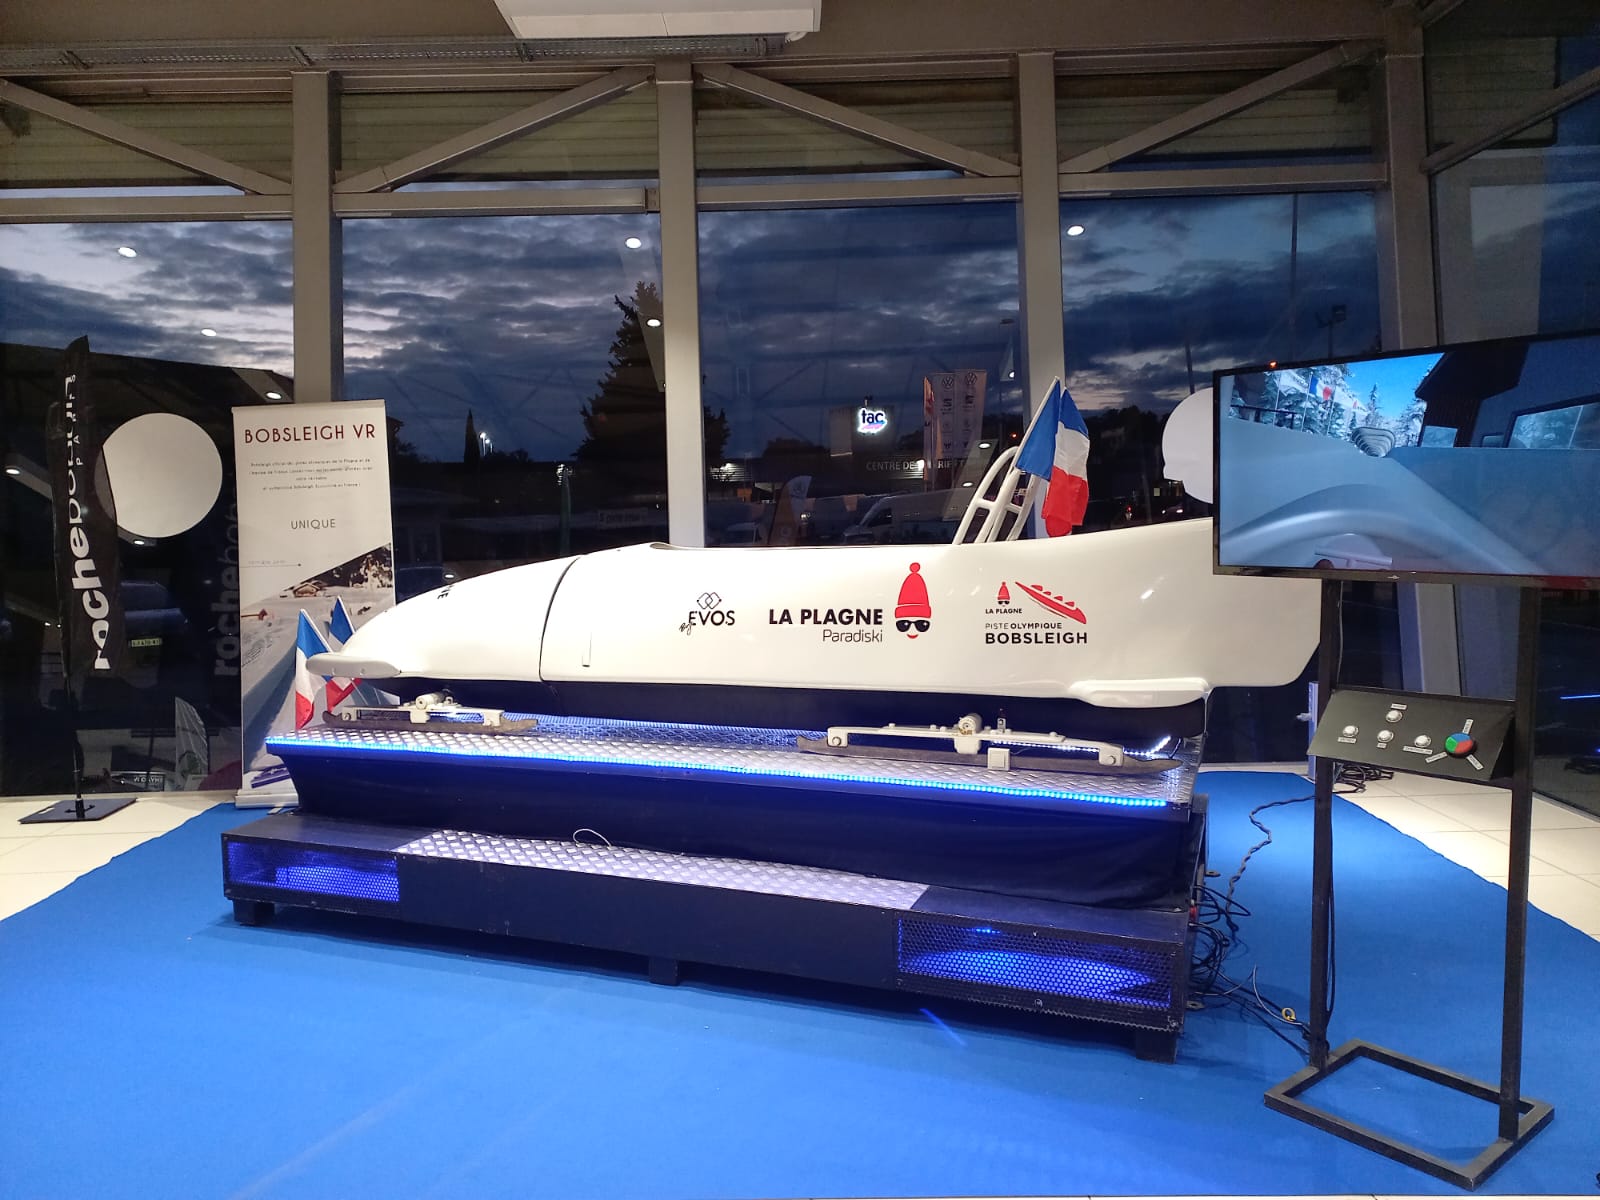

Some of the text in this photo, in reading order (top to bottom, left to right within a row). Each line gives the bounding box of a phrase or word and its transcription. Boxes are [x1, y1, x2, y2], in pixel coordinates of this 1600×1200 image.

[861, 409, 884, 424] tac
[244, 423, 376, 444] BOBSLEIGH VR
[866, 460, 900, 471] CENTRE
[902, 460, 915, 470] DE
[290, 518, 336, 530] UNIQUE
[769, 608, 883, 625] LA PLAGNE
[995, 607, 1023, 615] PLAGNE
[688, 610, 736, 626] EVOS
[985, 622, 1063, 630] PISTE OLYMPIQUE
[822, 629, 883, 643] Paradiski
[985, 632, 1088, 645] BOBSLEIGH
